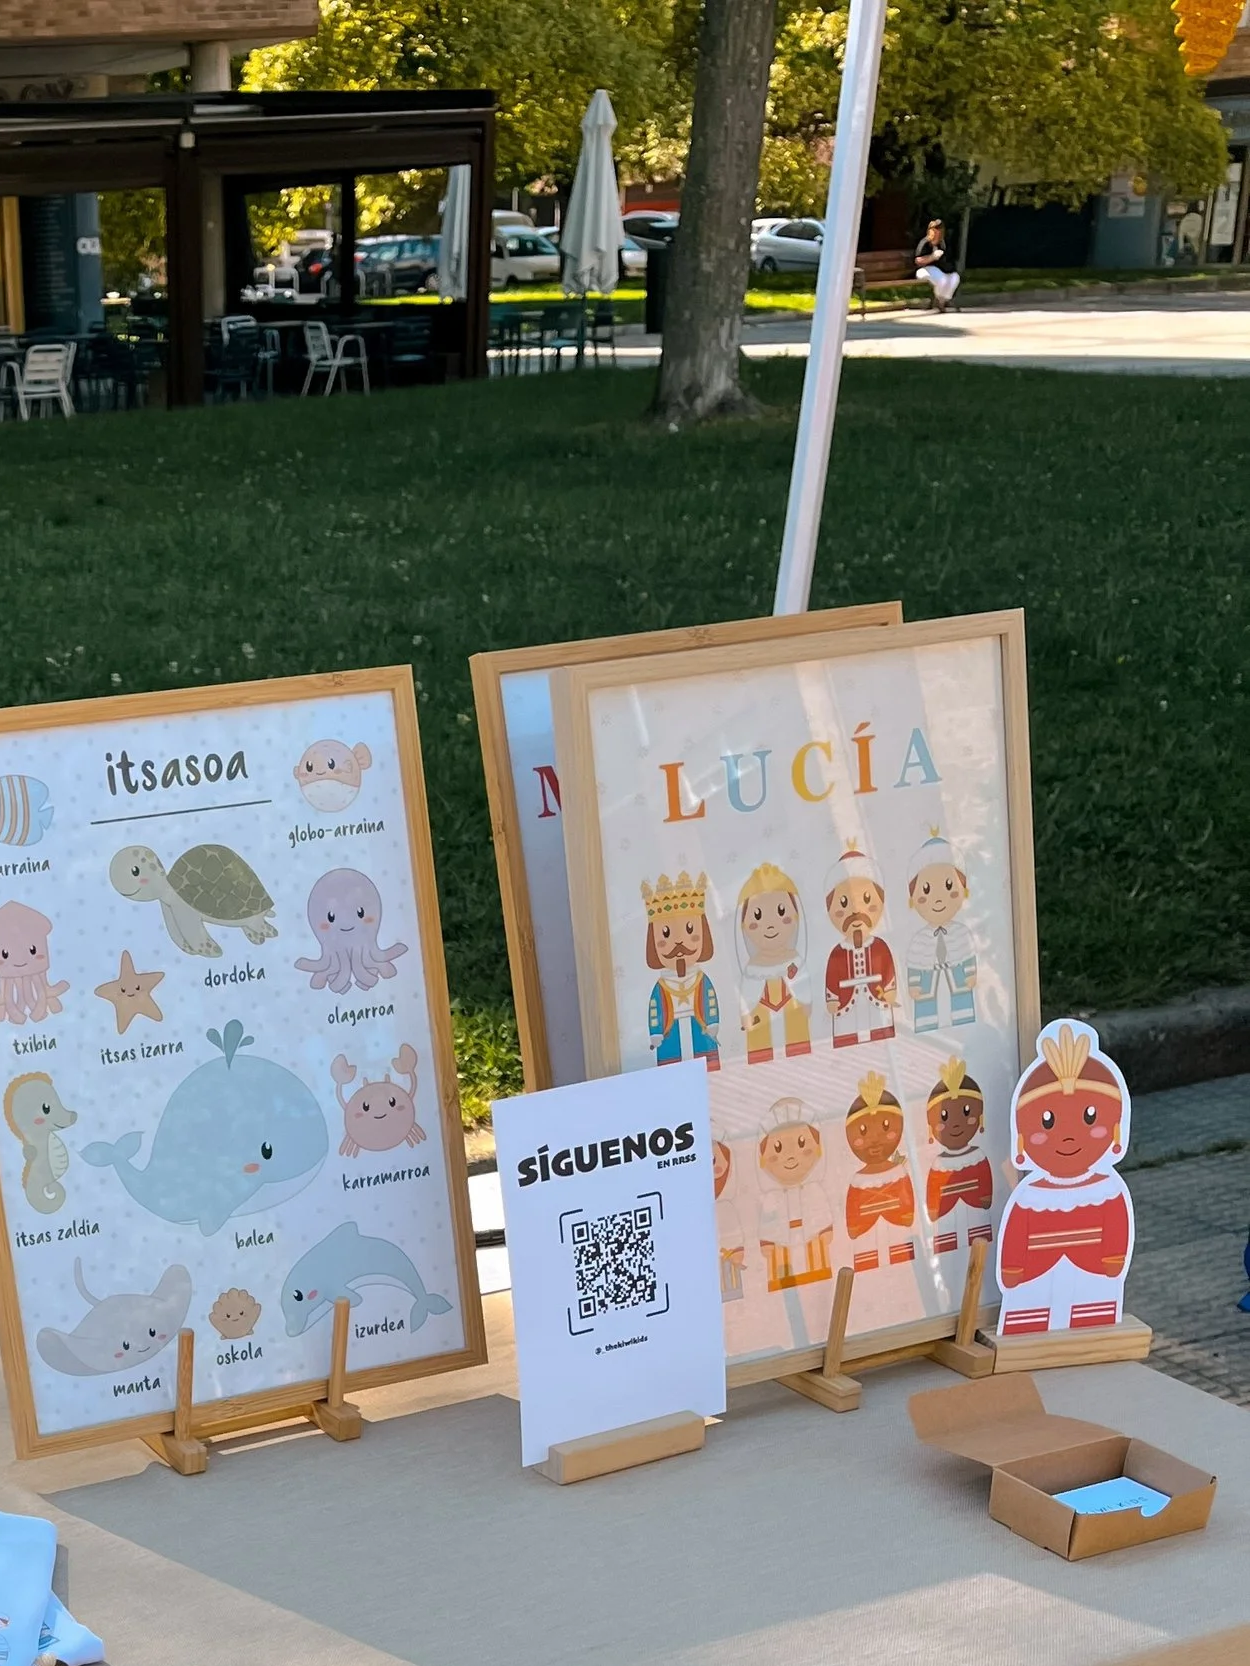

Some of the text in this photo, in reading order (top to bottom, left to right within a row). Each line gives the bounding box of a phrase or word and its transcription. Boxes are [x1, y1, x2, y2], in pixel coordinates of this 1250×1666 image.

[105, 749, 249, 797] itsasoa
[659, 722, 942, 822] LUCÍA
[288, 818, 385, 848] globo-arraina
[204, 965, 265, 988] dordoka
[327, 1001, 395, 1026] olagarroa
[12, 1034, 57, 1056] txibia
[100, 1040, 184, 1066] itsas izarra
[518, 1122, 695, 1187] SÍGUENOS
[657, 1153, 697, 1170] EN RRSS
[342, 1162, 431, 1192] karramarroa
[15, 1219, 100, 1248] itsas zaldia
[234, 1229, 275, 1250] balea
[355, 1316, 405, 1338] izurdea
[216, 1343, 263, 1366] oskola
[113, 1376, 161, 1397] manta
